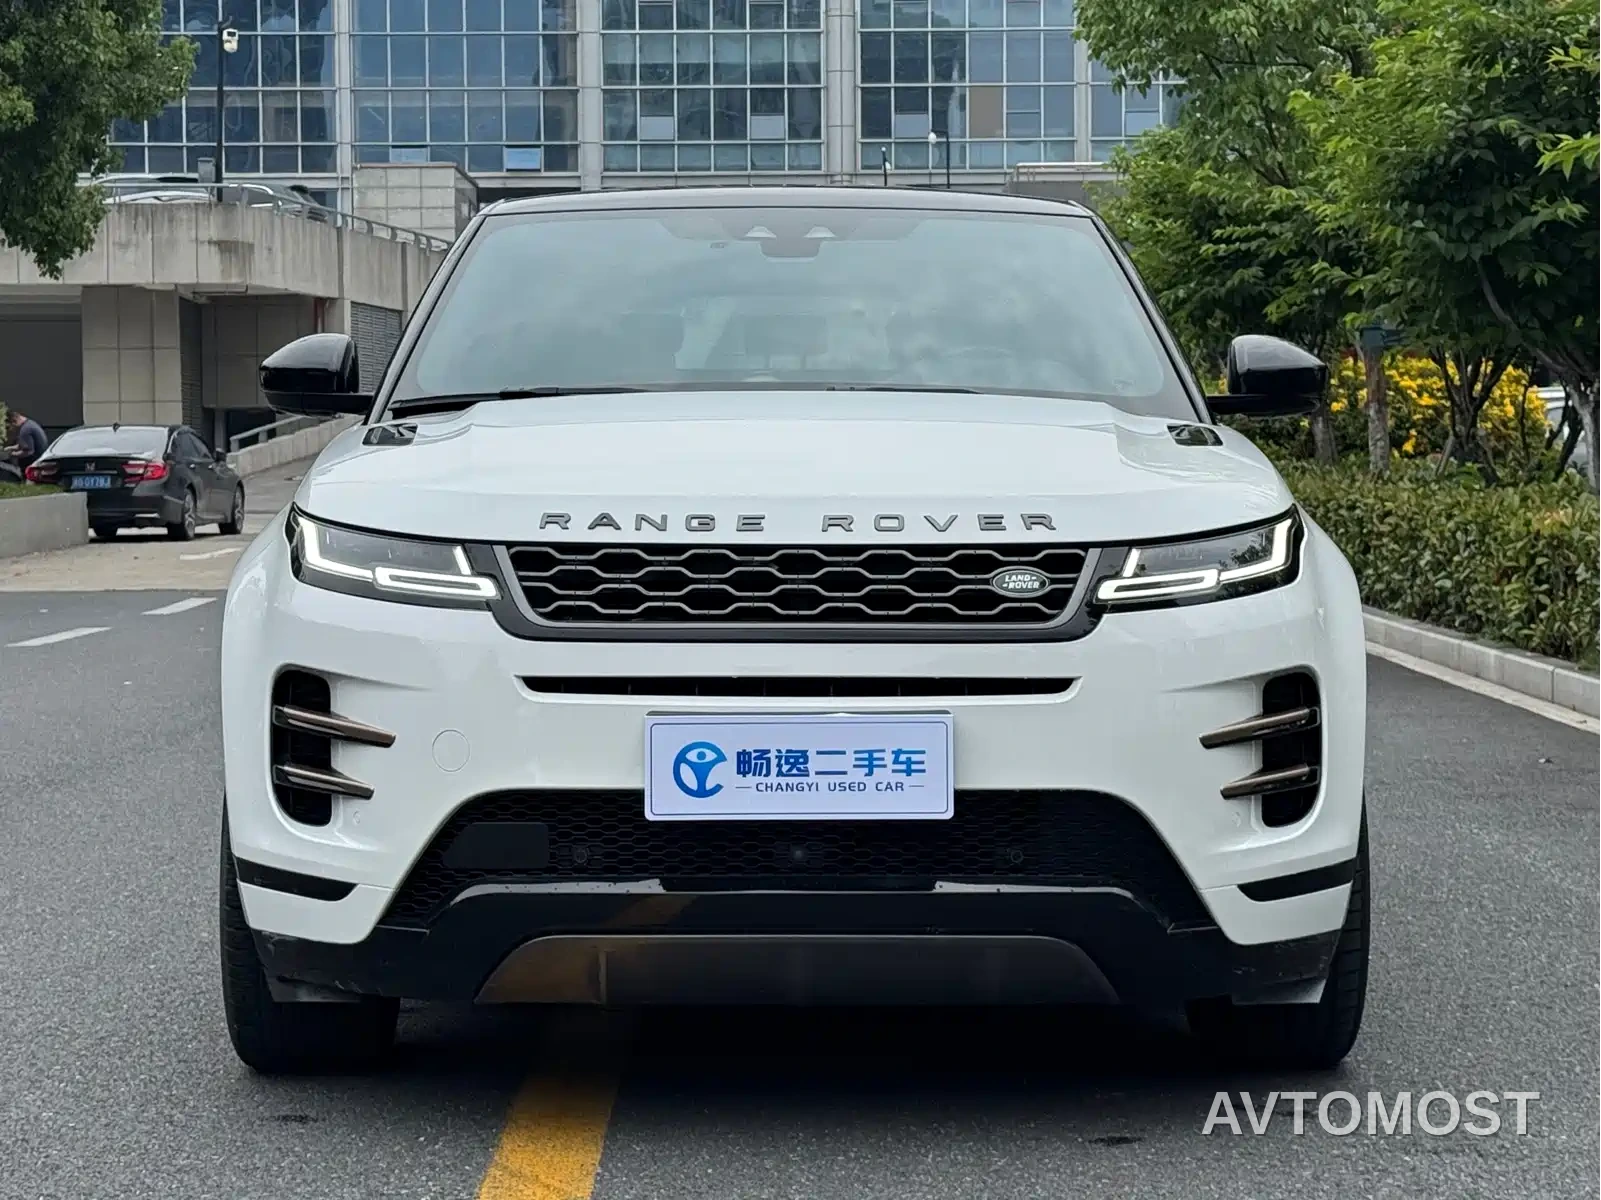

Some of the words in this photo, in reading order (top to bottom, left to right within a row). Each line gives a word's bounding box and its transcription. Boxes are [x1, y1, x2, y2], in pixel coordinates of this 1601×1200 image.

[539, 512, 766, 532] RANGE
[821, 513, 1057, 532] ROVER
[736, 748, 926, 778] 畅逸二手车
[755, 782, 819, 793] CHANGYI
[828, 782, 867, 792] USED
[875, 781, 905, 792] CAR
